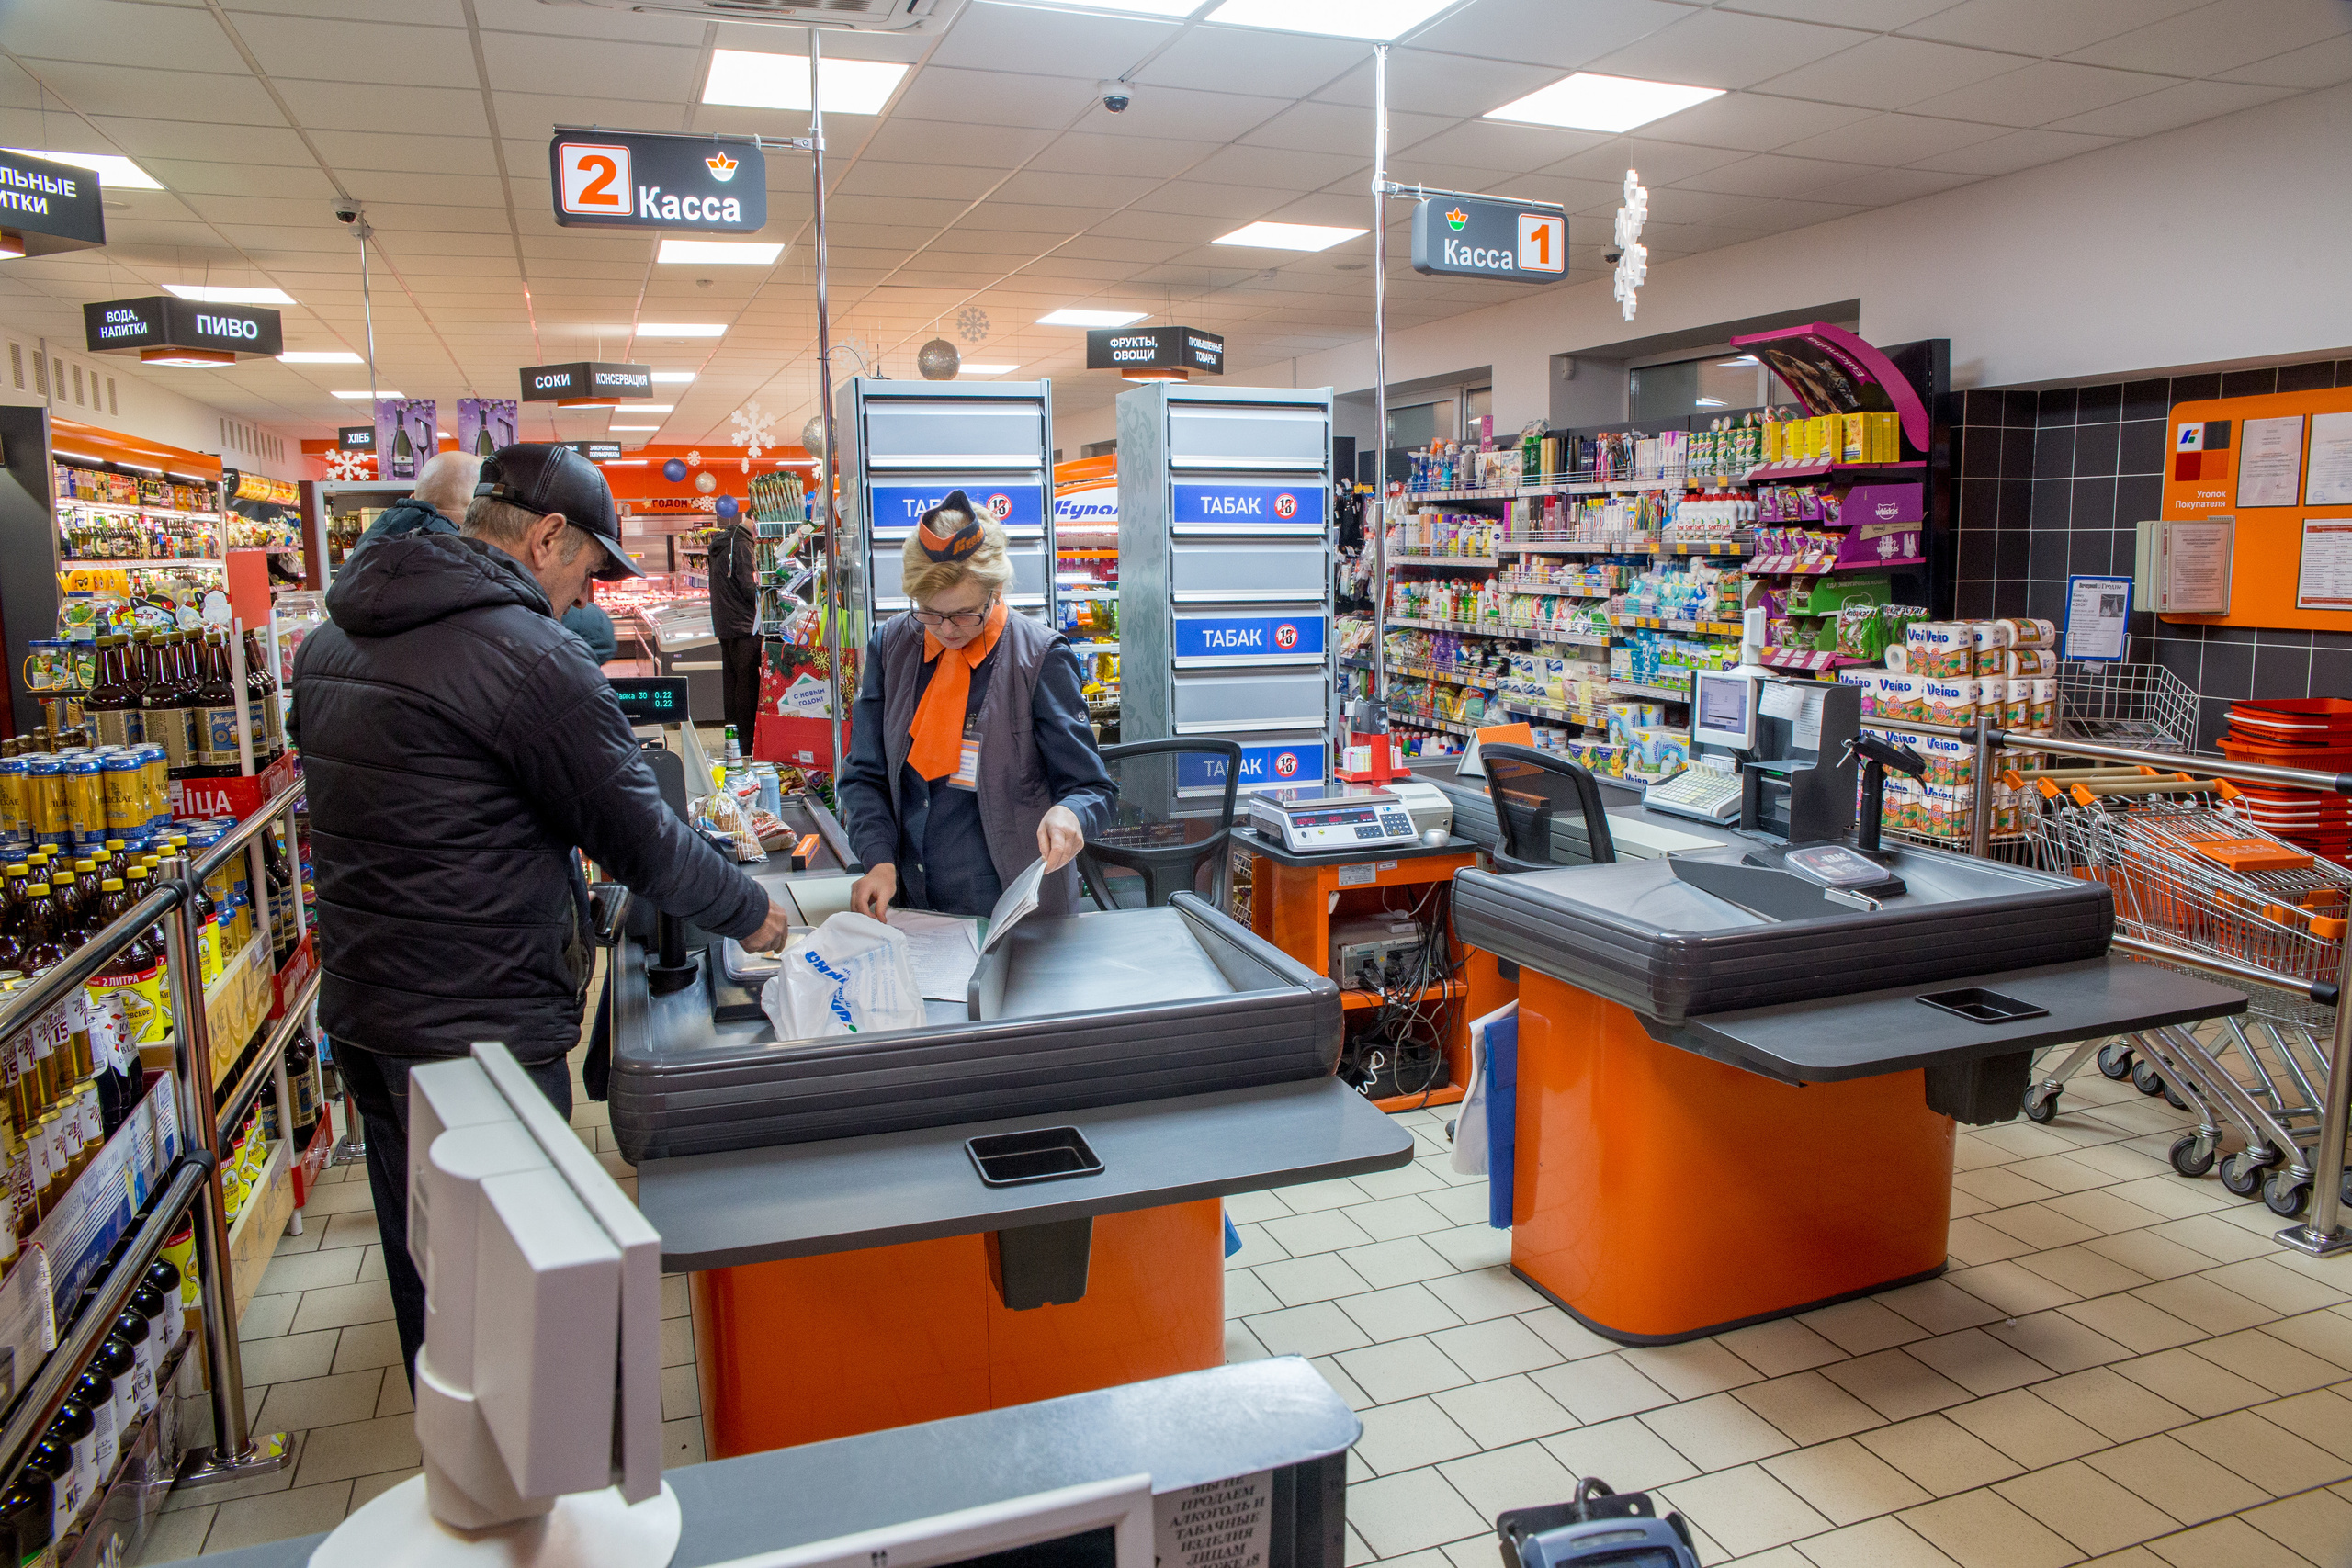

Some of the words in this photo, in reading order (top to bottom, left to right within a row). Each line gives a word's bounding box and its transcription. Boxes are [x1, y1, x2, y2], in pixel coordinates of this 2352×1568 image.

[577, 154, 619, 206] 2
[639, 186, 741, 222] Касса
[1531, 224, 1550, 265] 1
[1444, 238, 1513, 270] Касса
[106, 309, 139, 324] ВОДА,
[100, 322, 148, 339] НАПИТКИ
[196, 314, 258, 339] ПИВО
[1110, 336, 1158, 348] ФРУКТЫ,
[1188, 336, 1223, 354] ПРОМЫШЛЕННЫЕ
[1113, 349, 1155, 361] ОВОЩИ
[1195, 351, 1216, 365] ТОВАРЫ
[535, 373, 571, 389] СОКИ
[595, 372, 648, 388] КОНСЕРВАЦИЯ
[347, 432, 370, 444] ХЛЕБ
[2197, 490, 2226, 500] Уголок
[652, 499, 688, 508] ГОДОМ
[1200, 496, 1261, 514] ТАБАК
[2175, 499, 2226, 510] Покупателя
[1202, 628, 1262, 647] ТАБАК
[1907, 629, 1925, 641] Vei
[798, 696, 824, 706] ГОДОМ!
[799, 688, 825, 698] НОВЫМ
[102, 977, 108, 987] 2
[108, 974, 140, 987] ЛИТРА
[127, 1009, 150, 1019] евское
[120, 1043, 136, 1054] BLA
[1181, 1484, 1256, 1511] ПРОДАЕМ
[1169, 1500, 1250, 1529] АЛКОГОЛЬ
[1254, 1496, 1266, 1508] И
[1176, 1511, 1260, 1540] ТАБАЧНЫЕ
[1181, 1527, 1254, 1552] ИЗДЕЛИЯ
[1186, 1543, 1246, 1566] ЛИЦАМ
[1247, 1552, 1260, 1565] 18
